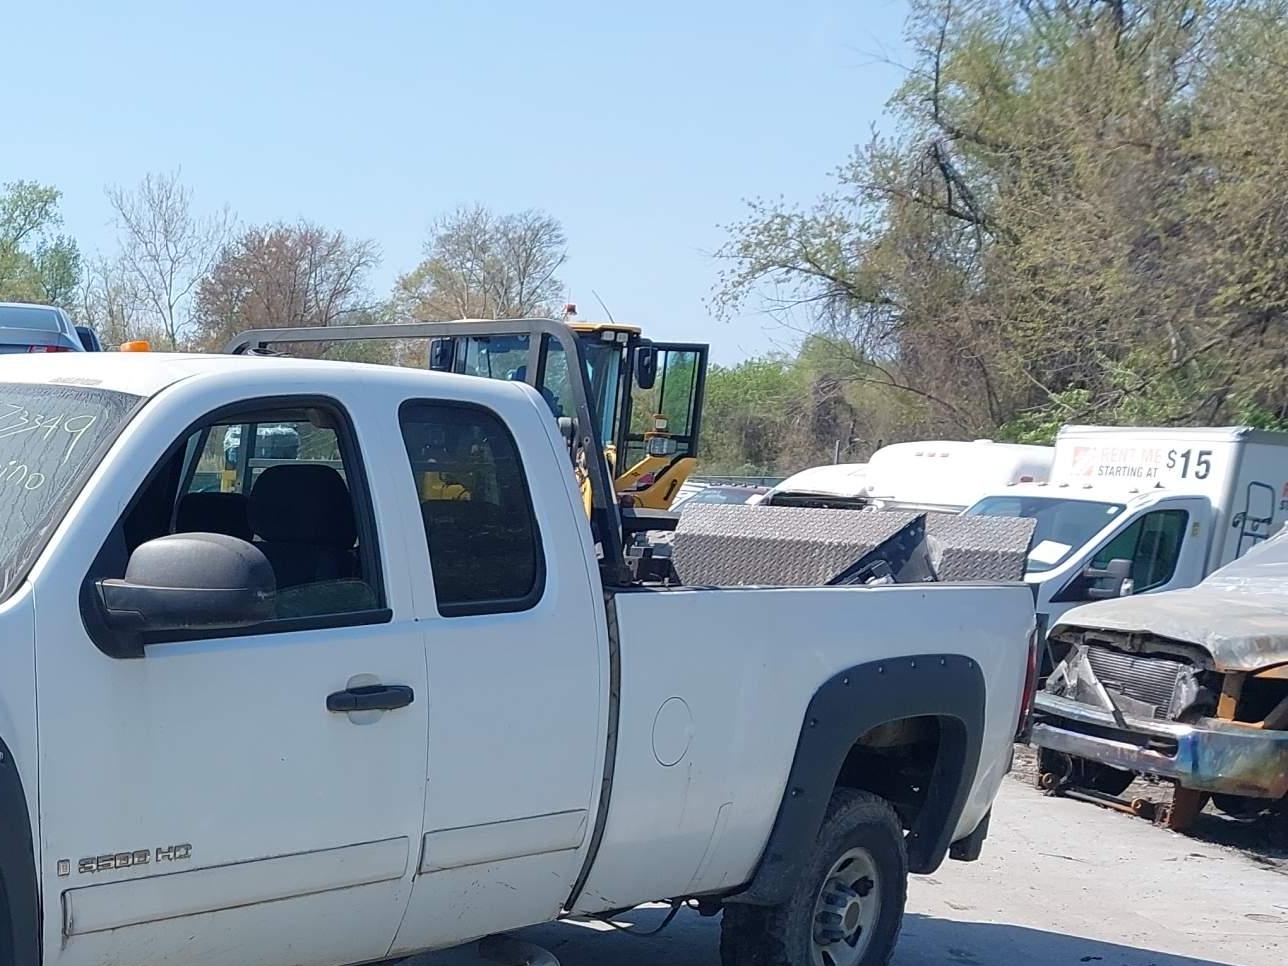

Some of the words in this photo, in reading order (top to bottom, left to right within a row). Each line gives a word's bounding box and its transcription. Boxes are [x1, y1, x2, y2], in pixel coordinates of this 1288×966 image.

[1101, 447, 1136, 463] RENT
[1141, 448, 1161, 464] ME
[1165, 448, 1213, 480] $15
[1097, 465, 1143, 478] STARTING
[1146, 467, 1159, 478] AT
[156, 844, 193, 862] HD
